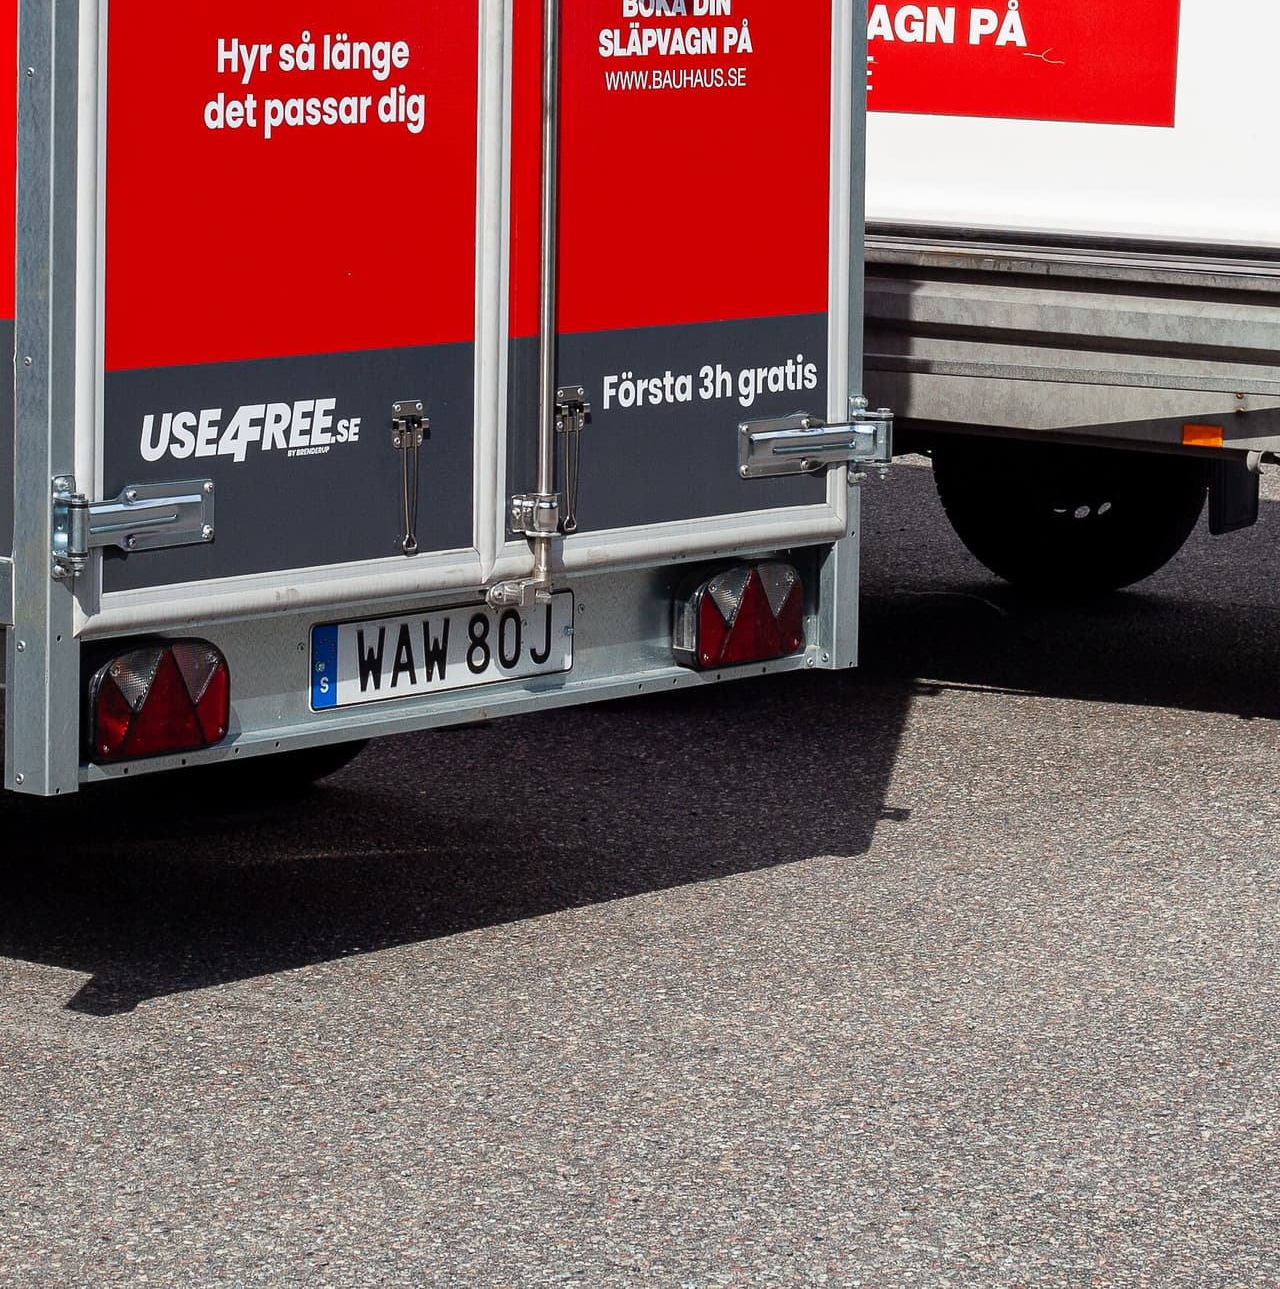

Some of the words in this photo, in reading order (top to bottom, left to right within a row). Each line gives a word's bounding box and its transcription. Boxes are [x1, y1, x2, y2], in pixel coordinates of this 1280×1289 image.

[217, 38, 272, 84] Hyr
[279, 30, 315, 71] så
[323, 33, 410, 81] länge
[598, 21, 717, 57] SLÄPVAGN
[723, 18, 753, 54] PÅ
[605, 67, 747, 91] WWW.BAUHAUS.SE
[204, 92, 257, 129] det
[264, 95, 372, 139] passar
[378, 84, 425, 134] dig
[603, 371, 693, 410] Första
[698, 364, 733, 400] 3h
[738, 353, 818, 408] gratis
[296, 446, 330, 456] BRENDERUP
[357, 616, 451, 693] WAW
[466, 603, 552, 675] 80J
